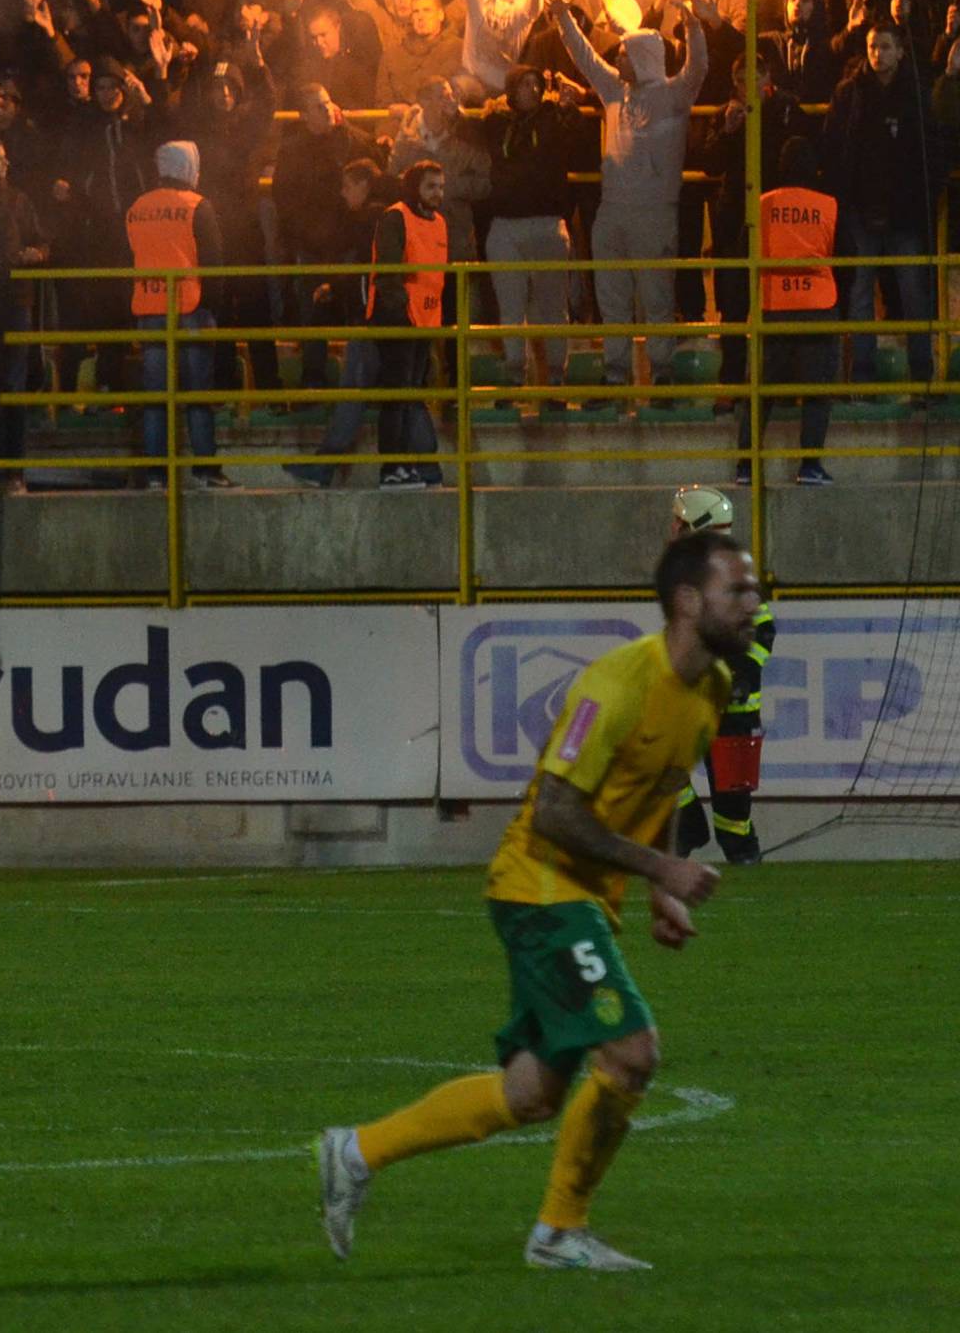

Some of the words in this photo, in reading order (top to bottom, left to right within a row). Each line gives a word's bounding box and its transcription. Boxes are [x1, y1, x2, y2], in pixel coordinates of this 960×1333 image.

[770, 207, 821, 225] REDAR
[782, 276, 812, 292] 815
[67, 769, 194, 790] UPRAVLJANJE
[205, 768, 334, 788] ENERGENTIMA
[571, 939, 608, 984] 5
